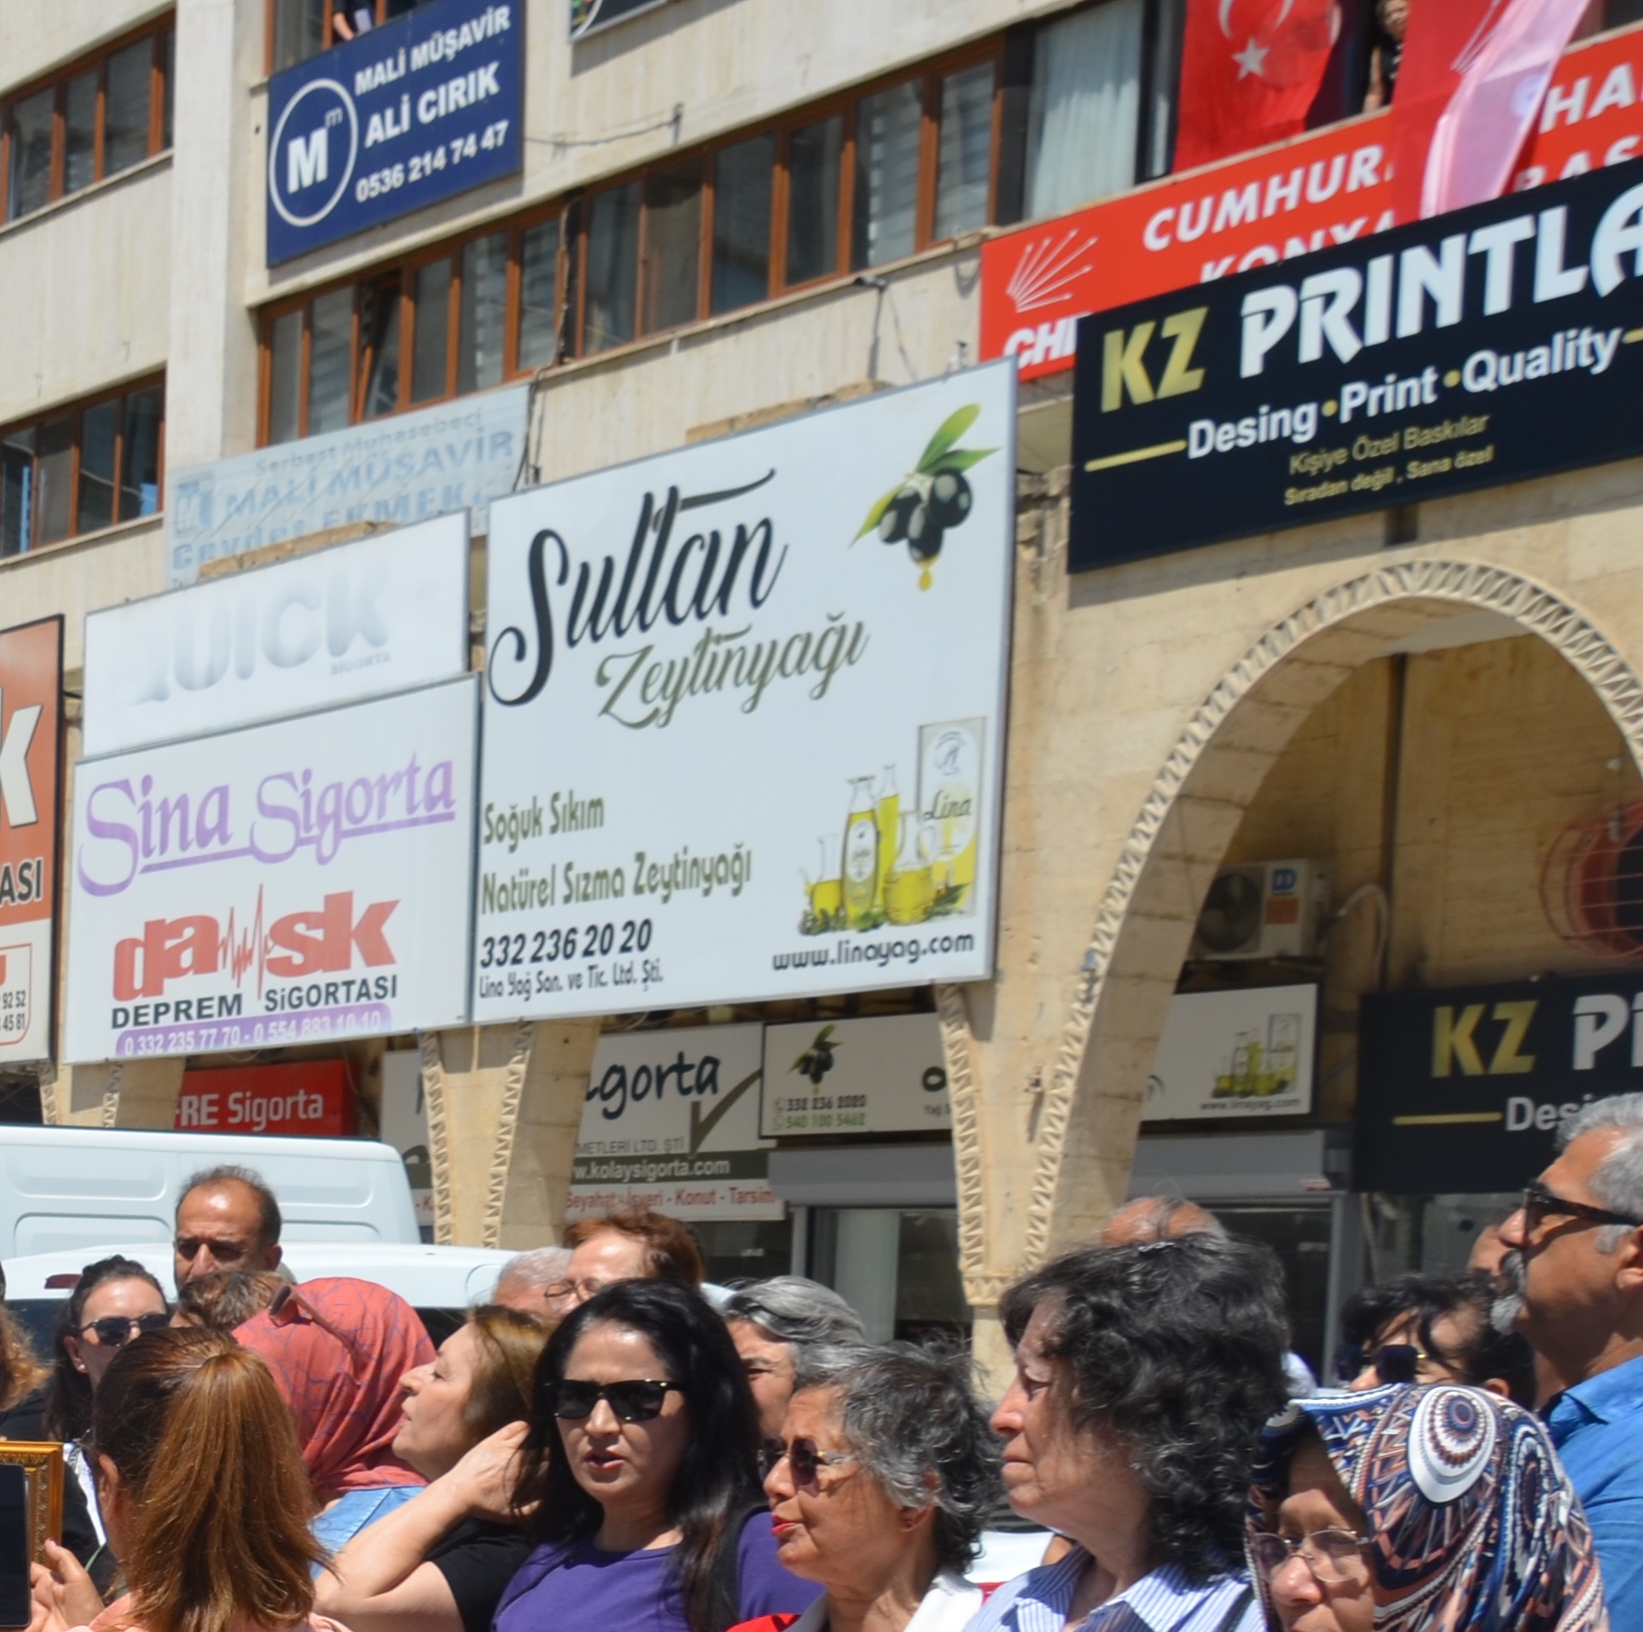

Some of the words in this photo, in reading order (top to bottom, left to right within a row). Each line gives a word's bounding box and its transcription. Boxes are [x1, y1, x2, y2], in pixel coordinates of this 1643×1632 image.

[354, 47, 407, 97] MALİ
[410, 5, 511, 72] MÜŞAVİR
[365, 93, 410, 149] ALİ
[417, 61, 501, 125] CIRIK
[355, 163, 405, 203] 0536
[408, 146, 447, 183] 214
[451, 133, 478, 165] 74
[480, 119, 510, 151] 47
[1143, 143, 1394, 252] CUMHUR
[1539, 62, 1643, 136] HA
[1101, 306, 1209, 413] KZ
[1188, 401, 1318, 460] Desing
[1339, 366, 1438, 424] Print
[1462, 327, 1623, 393] Quality
[1289, 446, 1349, 476] Kişiye
[1352, 432, 1400, 461] Özel
[1403, 415, 1491, 450] Baskılar
[489, 468, 789, 707] Sultan
[595, 611, 871, 730] Zeytinyağı
[77, 773, 233, 897] Sina
[250, 751, 456, 866] Sigorta
[483, 795, 544, 853] Soğuk
[549, 789, 605, 835] Sıkım
[481, 863, 556, 915] Natürel
[562, 860, 626, 905] Sızma
[632, 842, 752, 904] Zeytinyağı
[480, 934, 527, 969] 332
[530, 927, 579, 963] 236
[582, 922, 615, 958] 20
[619, 918, 653, 954] 20
[772, 933, 975, 972] www.linayag.com
[111, 992, 243, 1030] DEPREM
[567, 970, 583, 991] ve
[137, 1034, 164, 1055] 332
[168, 1031, 195, 1052] 235
[222, 1025, 241, 1046] 70
[1431, 999, 1539, 1078] KZ
[227, 1089, 324, 1132] Sigorta
[584, 1051, 721, 1121] gorta
[574, 1158, 731, 1185] w.kolaysigorta.com
[578, 1136, 632, 1156] METLERİ
